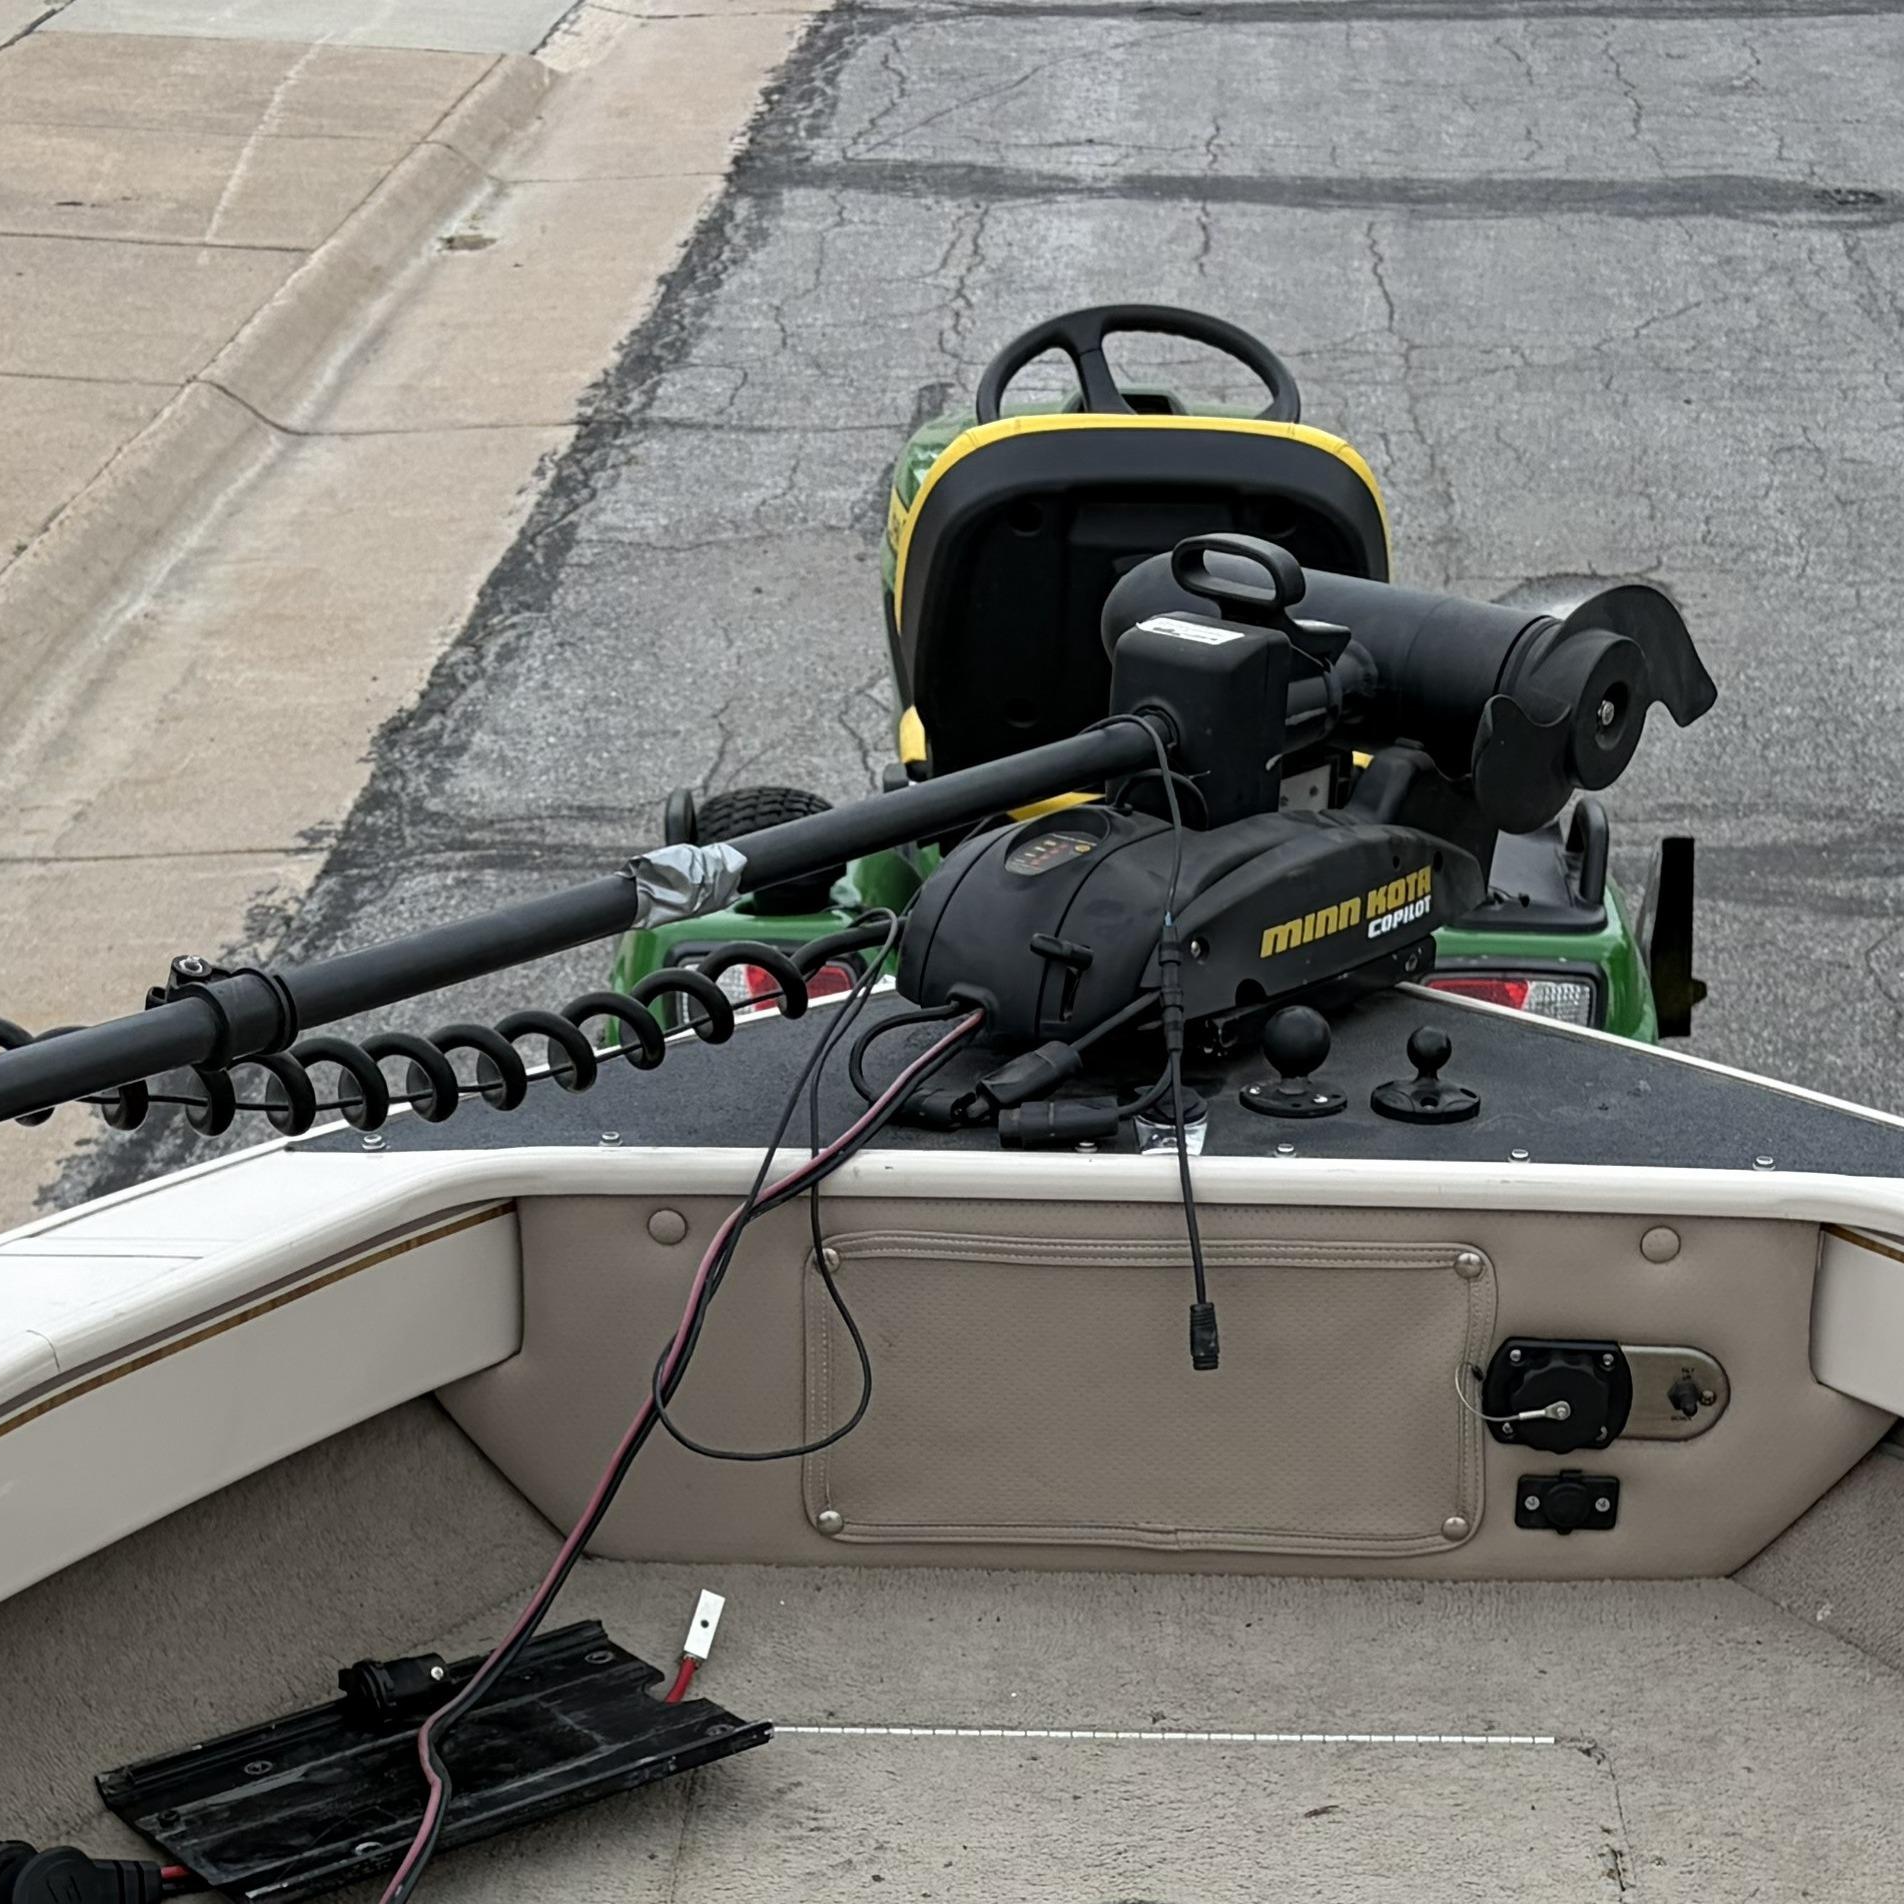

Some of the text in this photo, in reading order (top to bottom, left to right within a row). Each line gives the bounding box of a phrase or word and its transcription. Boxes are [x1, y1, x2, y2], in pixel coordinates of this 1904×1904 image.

[1259, 865, 1433, 959] MINN KOTA
[1367, 894, 1432, 939] COPILOT
